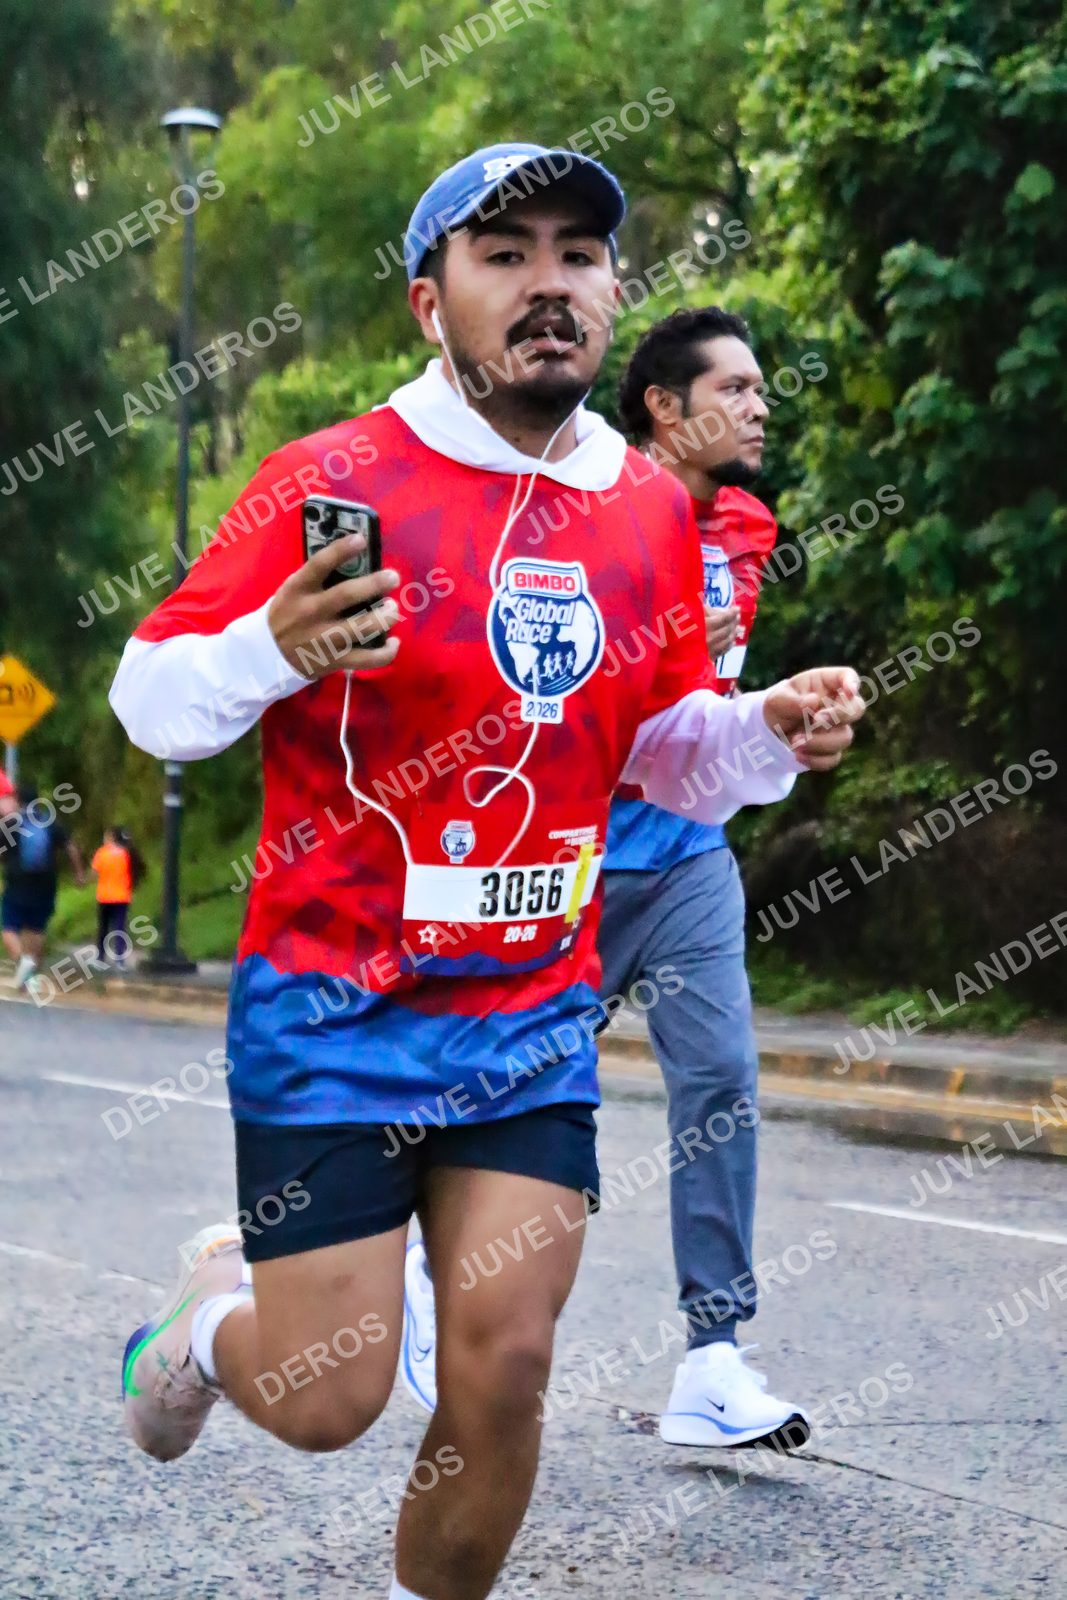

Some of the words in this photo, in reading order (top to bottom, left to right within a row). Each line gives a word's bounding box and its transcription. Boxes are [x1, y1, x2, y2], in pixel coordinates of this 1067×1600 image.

[513, 572, 576, 592] BIMBO
[515, 597, 577, 625] Global
[504, 618, 553, 644] Race
[478, 867, 565, 917] 3056
